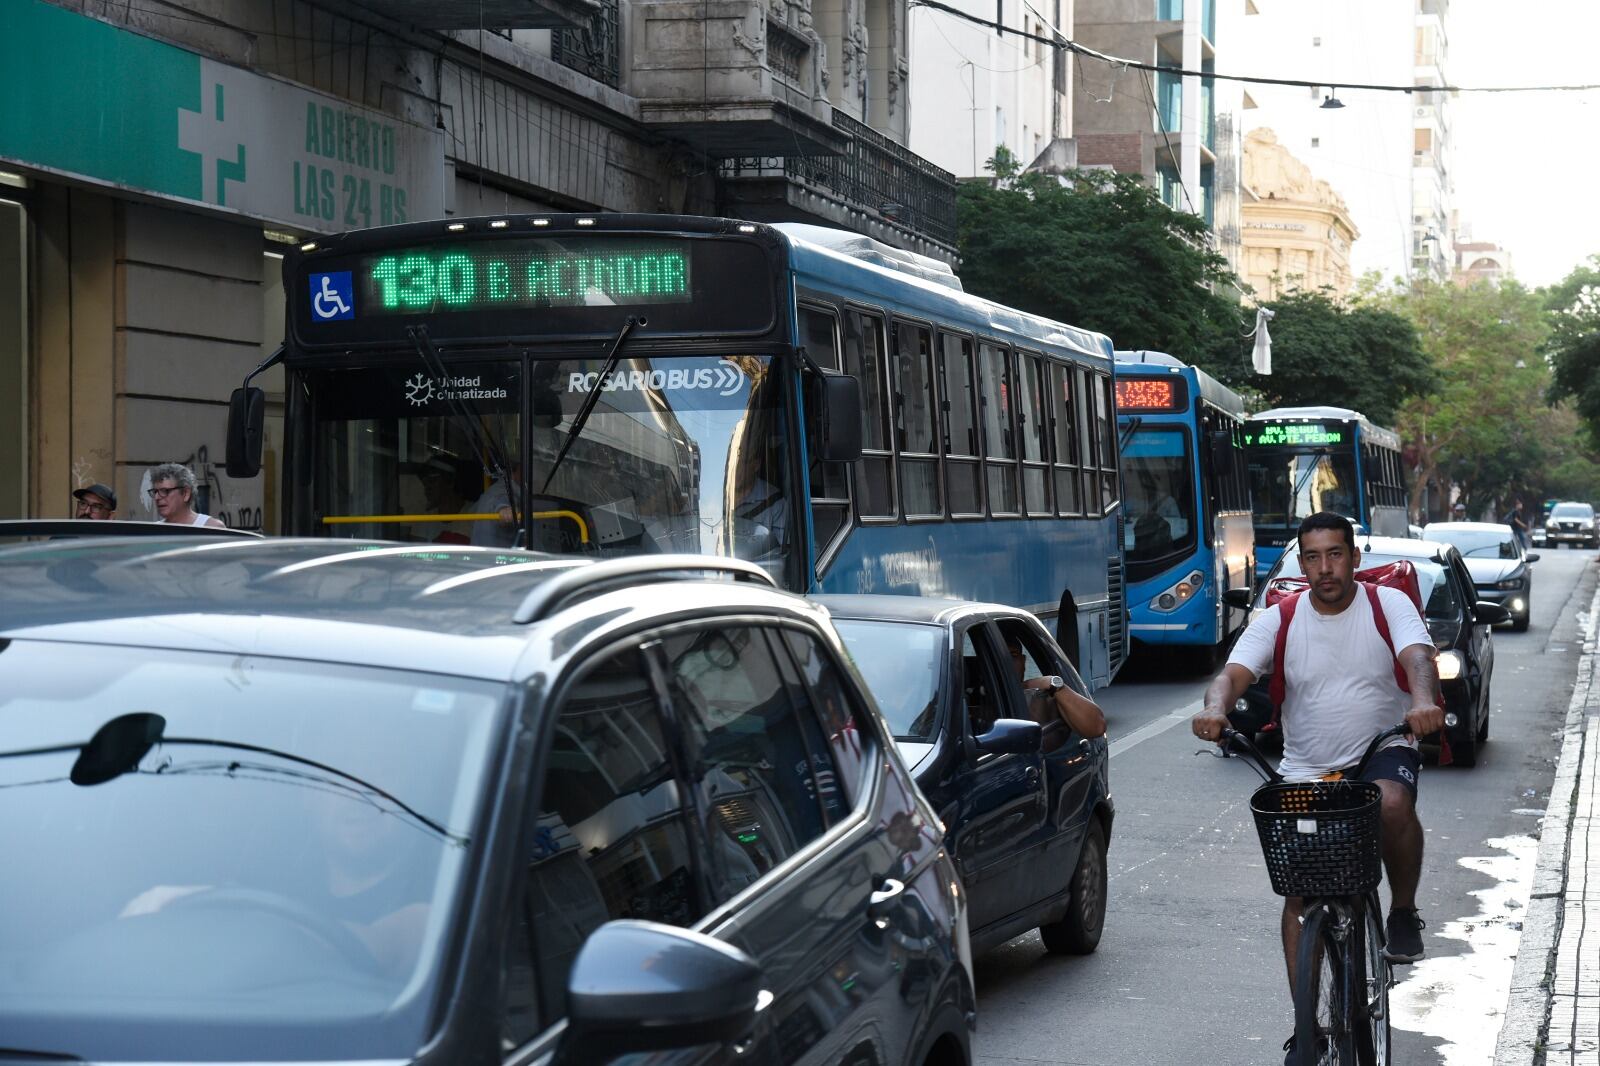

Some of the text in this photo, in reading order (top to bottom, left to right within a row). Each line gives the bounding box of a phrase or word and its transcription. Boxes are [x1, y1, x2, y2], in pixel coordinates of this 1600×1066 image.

[305, 101, 395, 175] ABIERTO
[293, 160, 335, 221] LAS
[342, 174, 372, 227] 24
[372, 255, 475, 307] 130
[528, 254, 685, 298] ACINDAR
